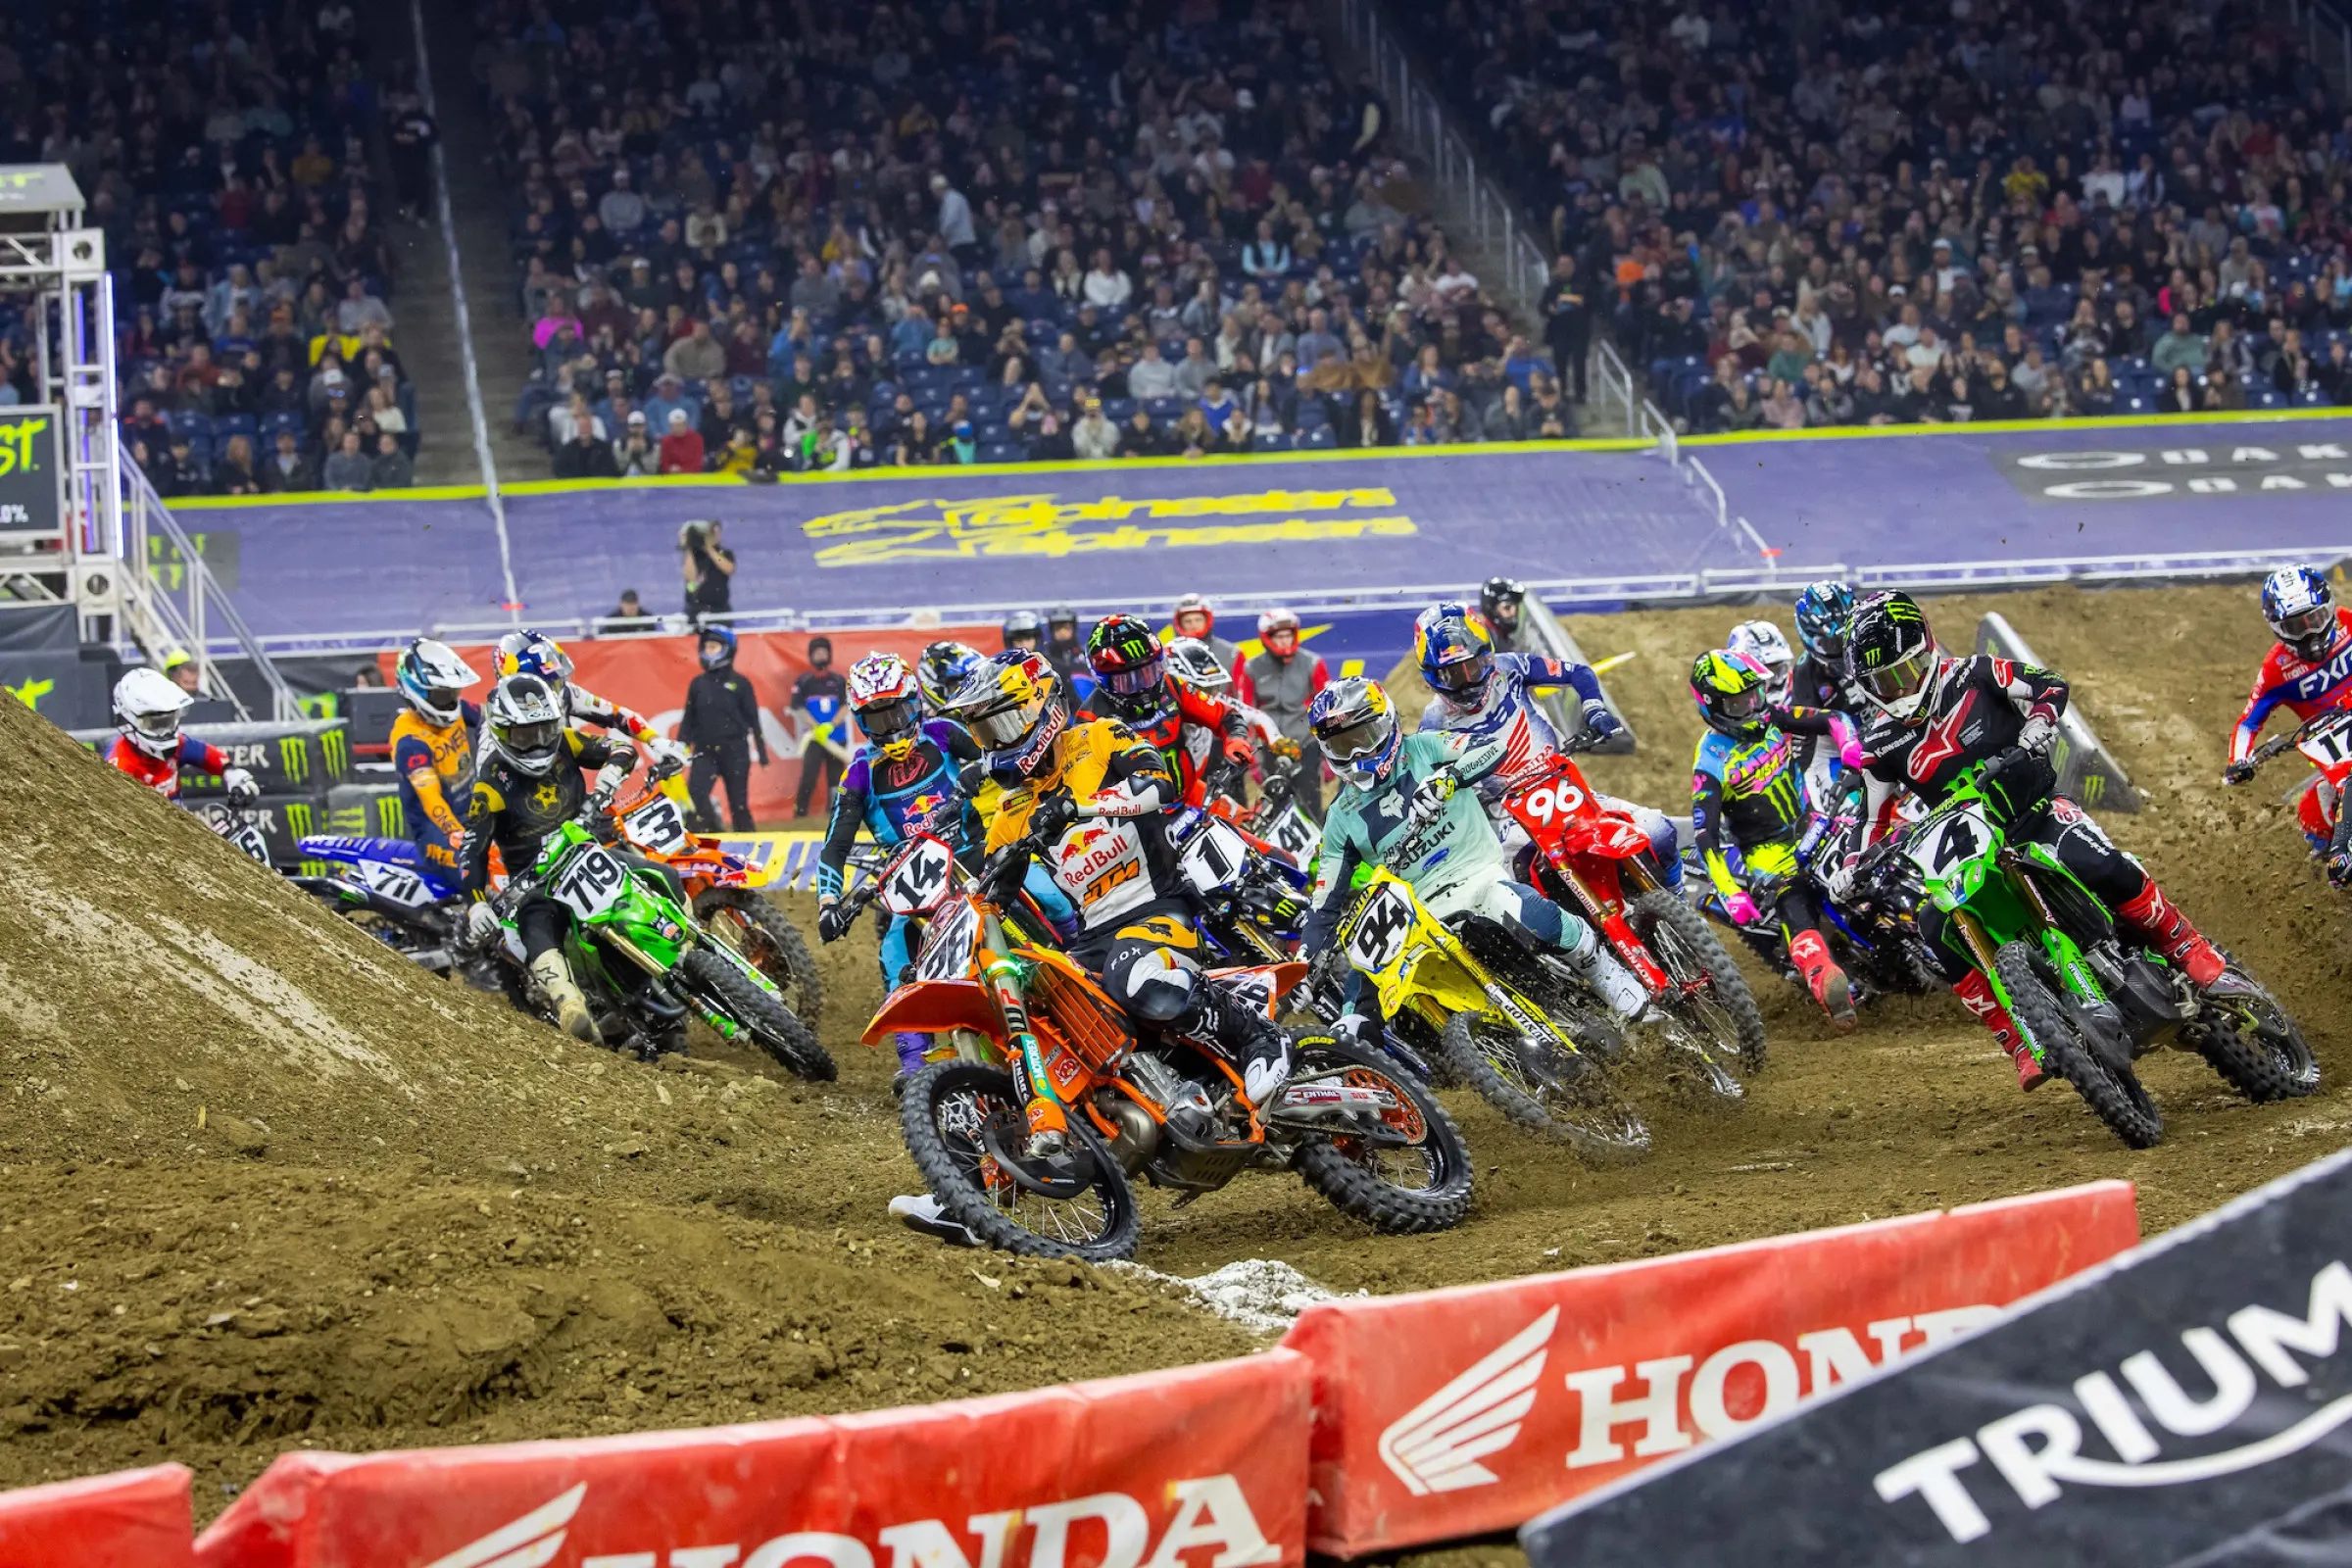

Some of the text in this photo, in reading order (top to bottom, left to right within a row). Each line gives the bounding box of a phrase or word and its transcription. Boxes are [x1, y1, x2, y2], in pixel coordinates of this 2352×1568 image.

[1874, 729, 1918, 759] Kawasaki
[636, 803, 683, 849] 3
[1526, 776, 1585, 827] 96
[1196, 834, 1236, 883] 1
[1277, 811, 1312, 855] 41
[1933, 813, 1979, 875] 4
[374, 866, 421, 903] 711
[562, 851, 619, 913] 719
[895, 849, 947, 911] 14
[1064, 834, 1129, 888] Red Bull
[1082, 857, 1140, 909] KTM
[1357, 897, 1408, 966] 94
[1109, 946, 1144, 971] FOX
